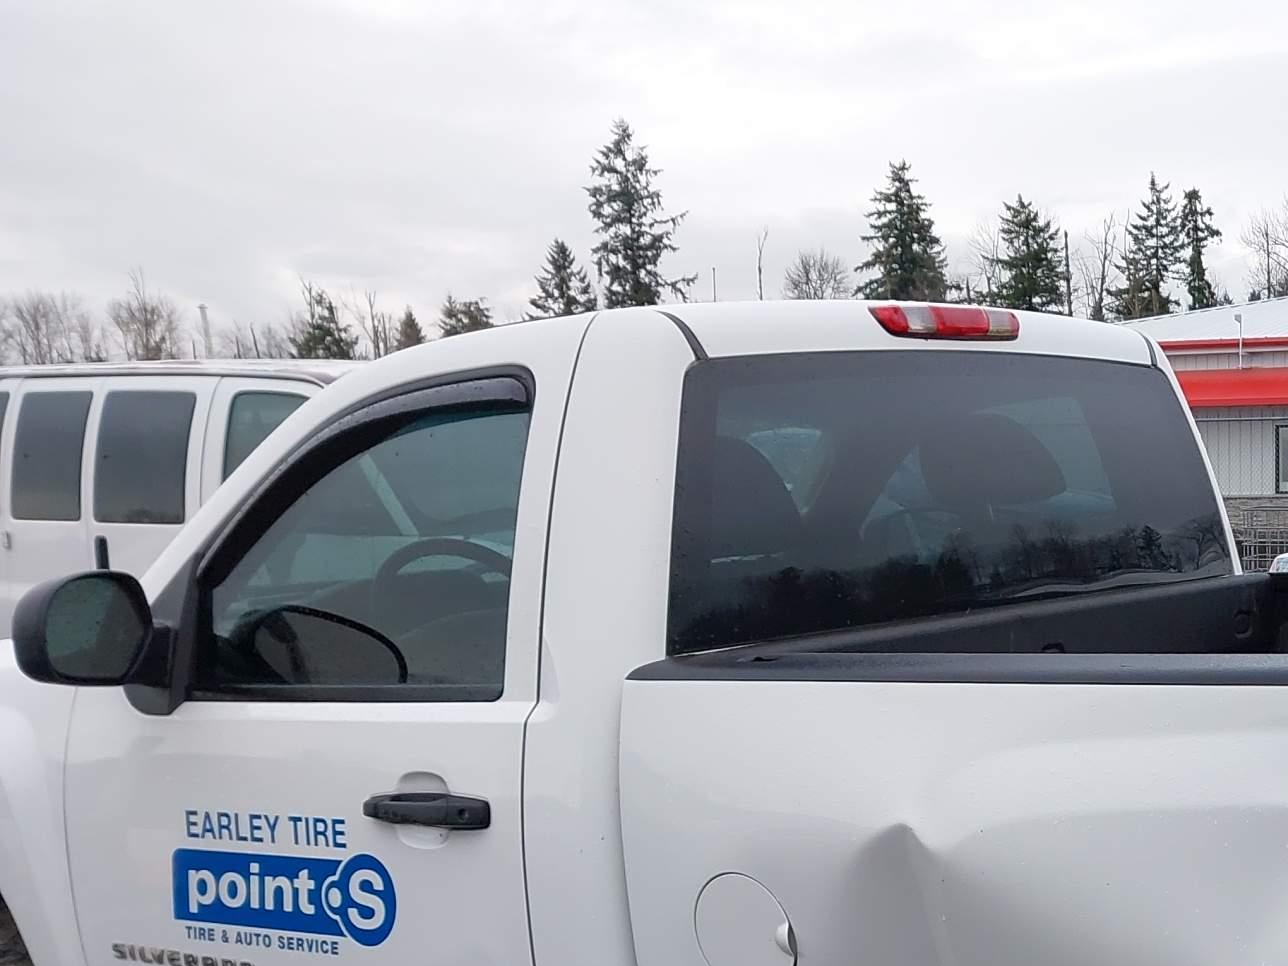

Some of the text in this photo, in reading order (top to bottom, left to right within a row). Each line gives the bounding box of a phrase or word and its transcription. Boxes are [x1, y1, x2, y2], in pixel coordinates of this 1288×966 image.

[185, 810, 347, 848] EARLEY TIRE
[188, 863, 315, 914] point
[185, 925, 340, 956] TIRE & AUTO SERVICE
